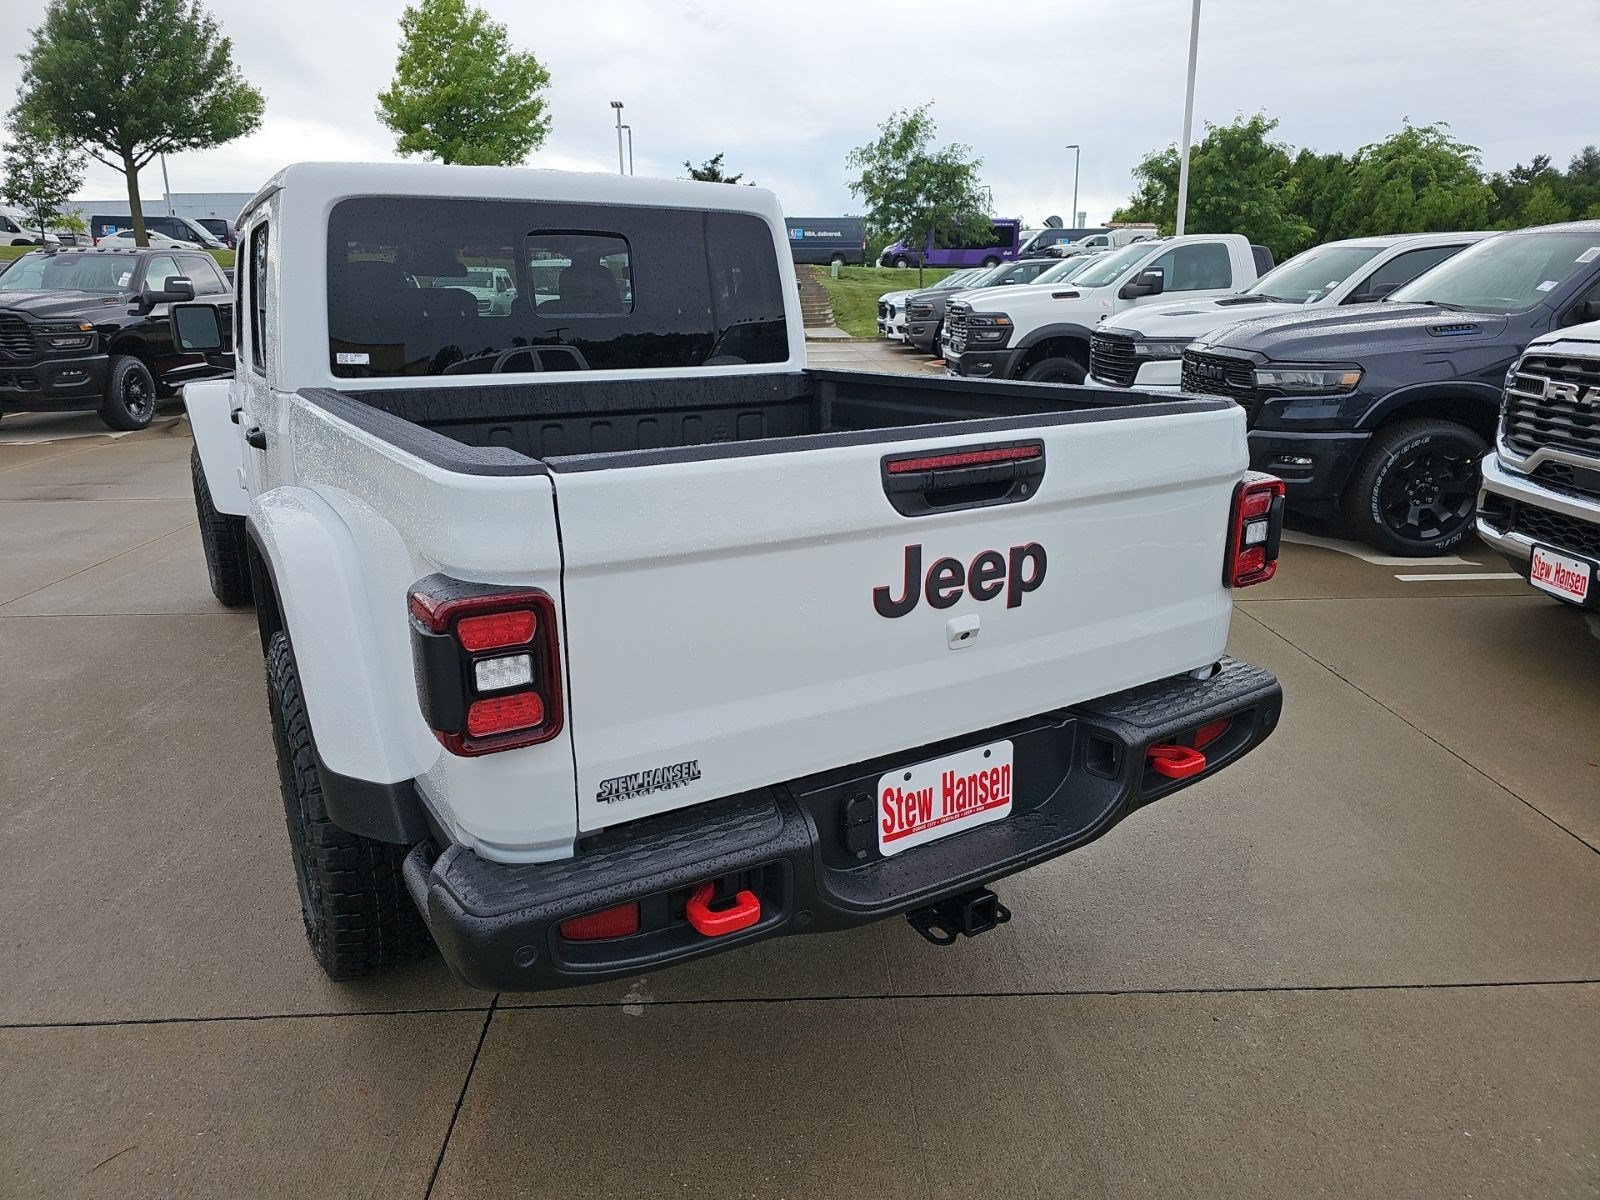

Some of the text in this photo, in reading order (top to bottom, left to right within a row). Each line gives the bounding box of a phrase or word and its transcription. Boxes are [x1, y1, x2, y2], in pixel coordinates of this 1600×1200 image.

[873, 542, 1048, 619] Jeep
[1533, 554, 1553, 579] Stew
[1554, 562, 1587, 592] Hansen
[600, 760, 699, 797] STEW HANSEN
[608, 779, 692, 804] DODGE CITY
[882, 763, 1011, 834] Stew Hansen
